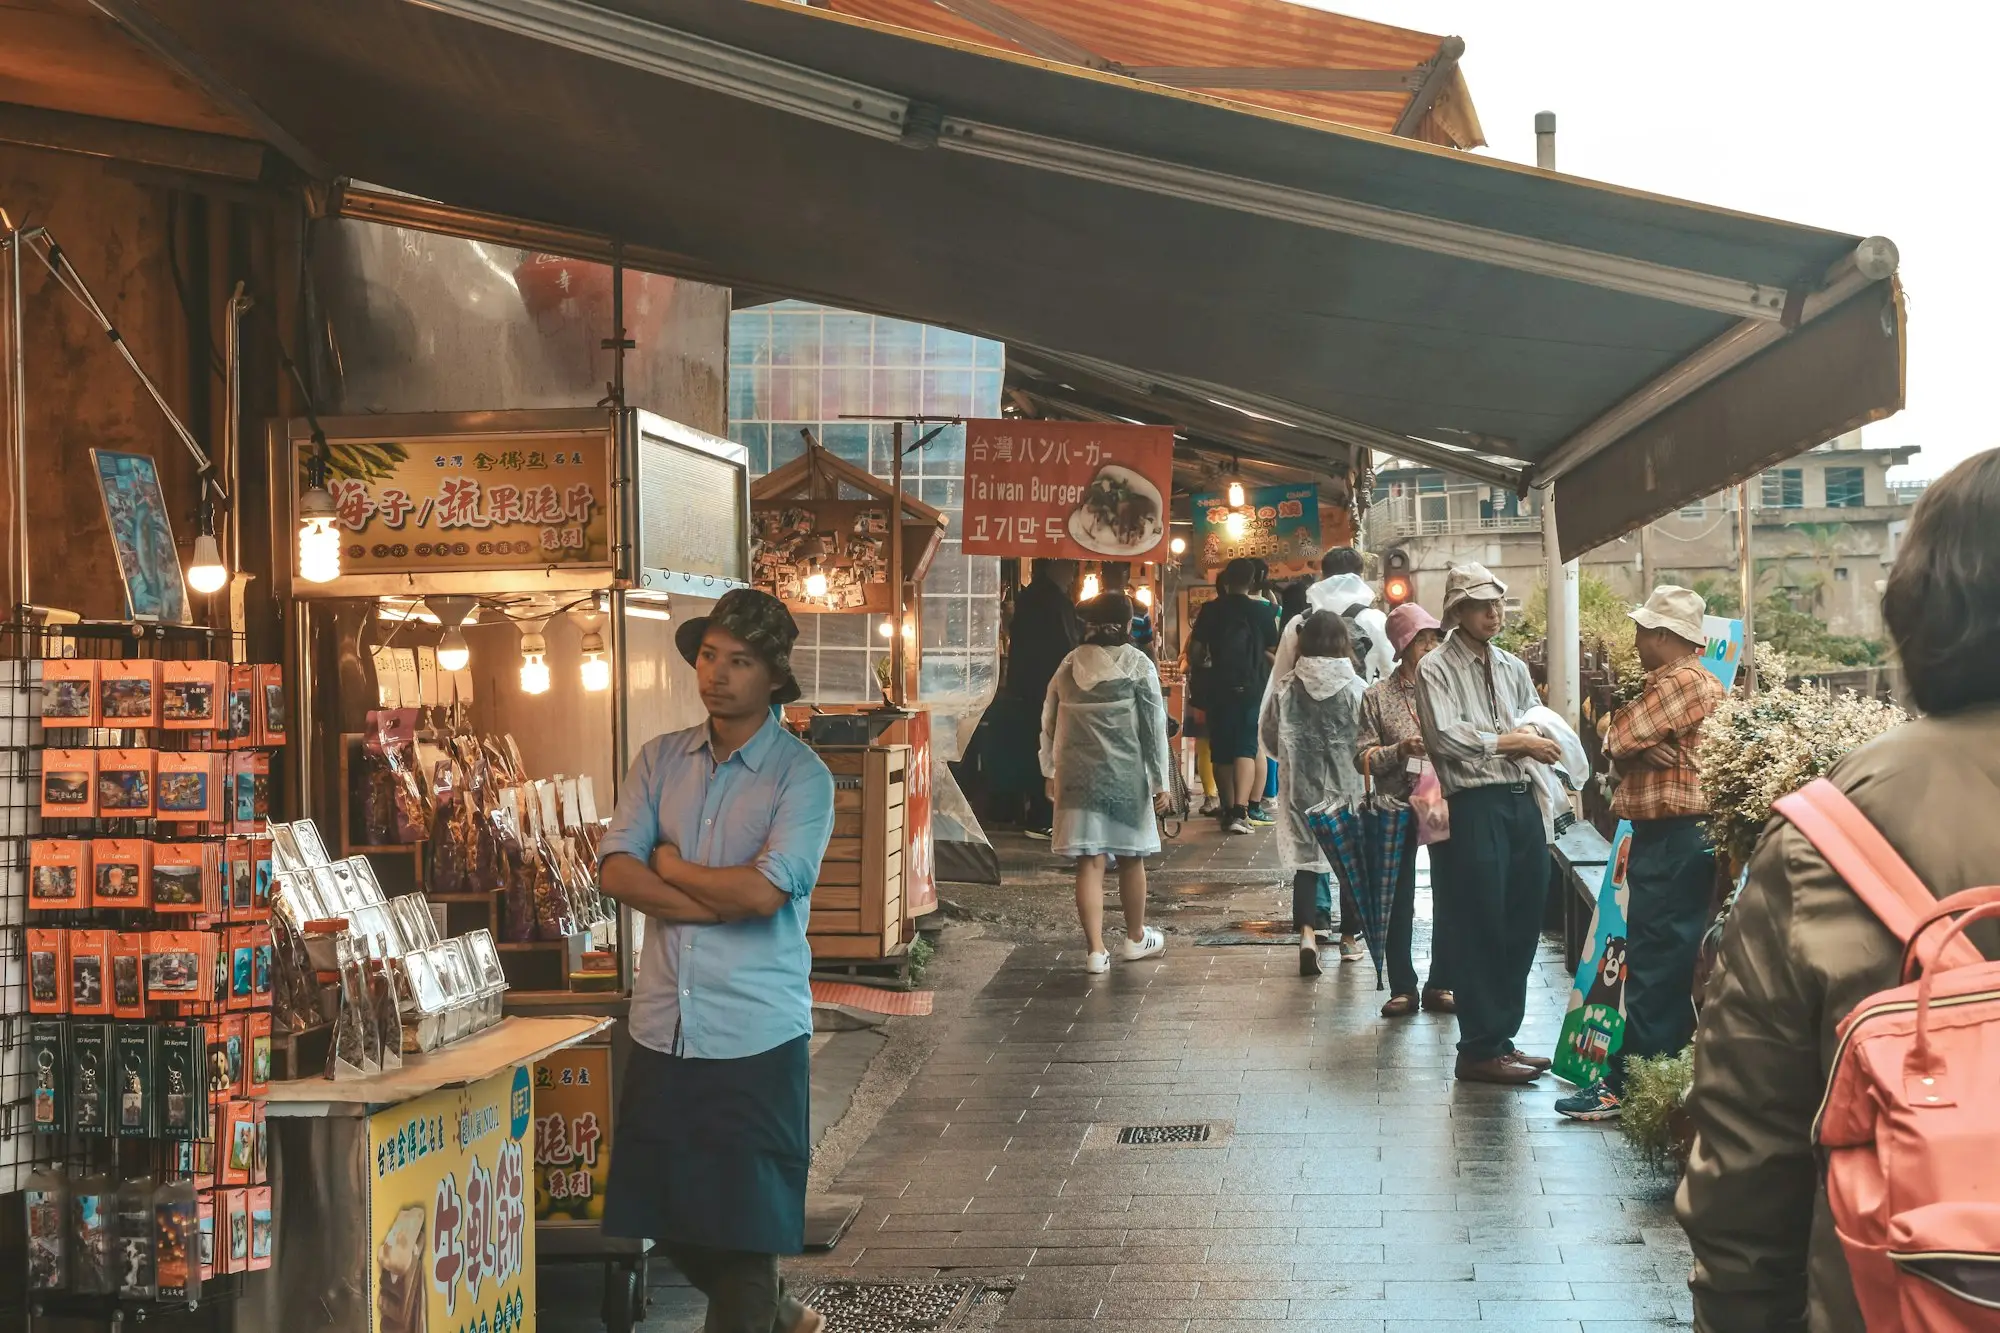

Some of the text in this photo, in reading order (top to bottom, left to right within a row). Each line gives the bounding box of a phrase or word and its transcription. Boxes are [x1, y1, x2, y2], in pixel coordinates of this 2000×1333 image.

[435, 455, 463, 468] 台灣
[473, 451, 547, 471] 金得立
[971, 435, 1113, 467] 台灣ハンバーガー
[970, 474, 1085, 506] Taiwan Burger
[541, 527, 583, 549] 系列
[968, 515, 1066, 545] 고기만두
[560, 1066, 592, 1086] 名產
[483, 1104, 500, 1135] NO.1
[534, 1112, 602, 1165] 脆片
[550, 1169, 592, 1199] 系列
[433, 1138, 525, 1316] 牛軋餅
